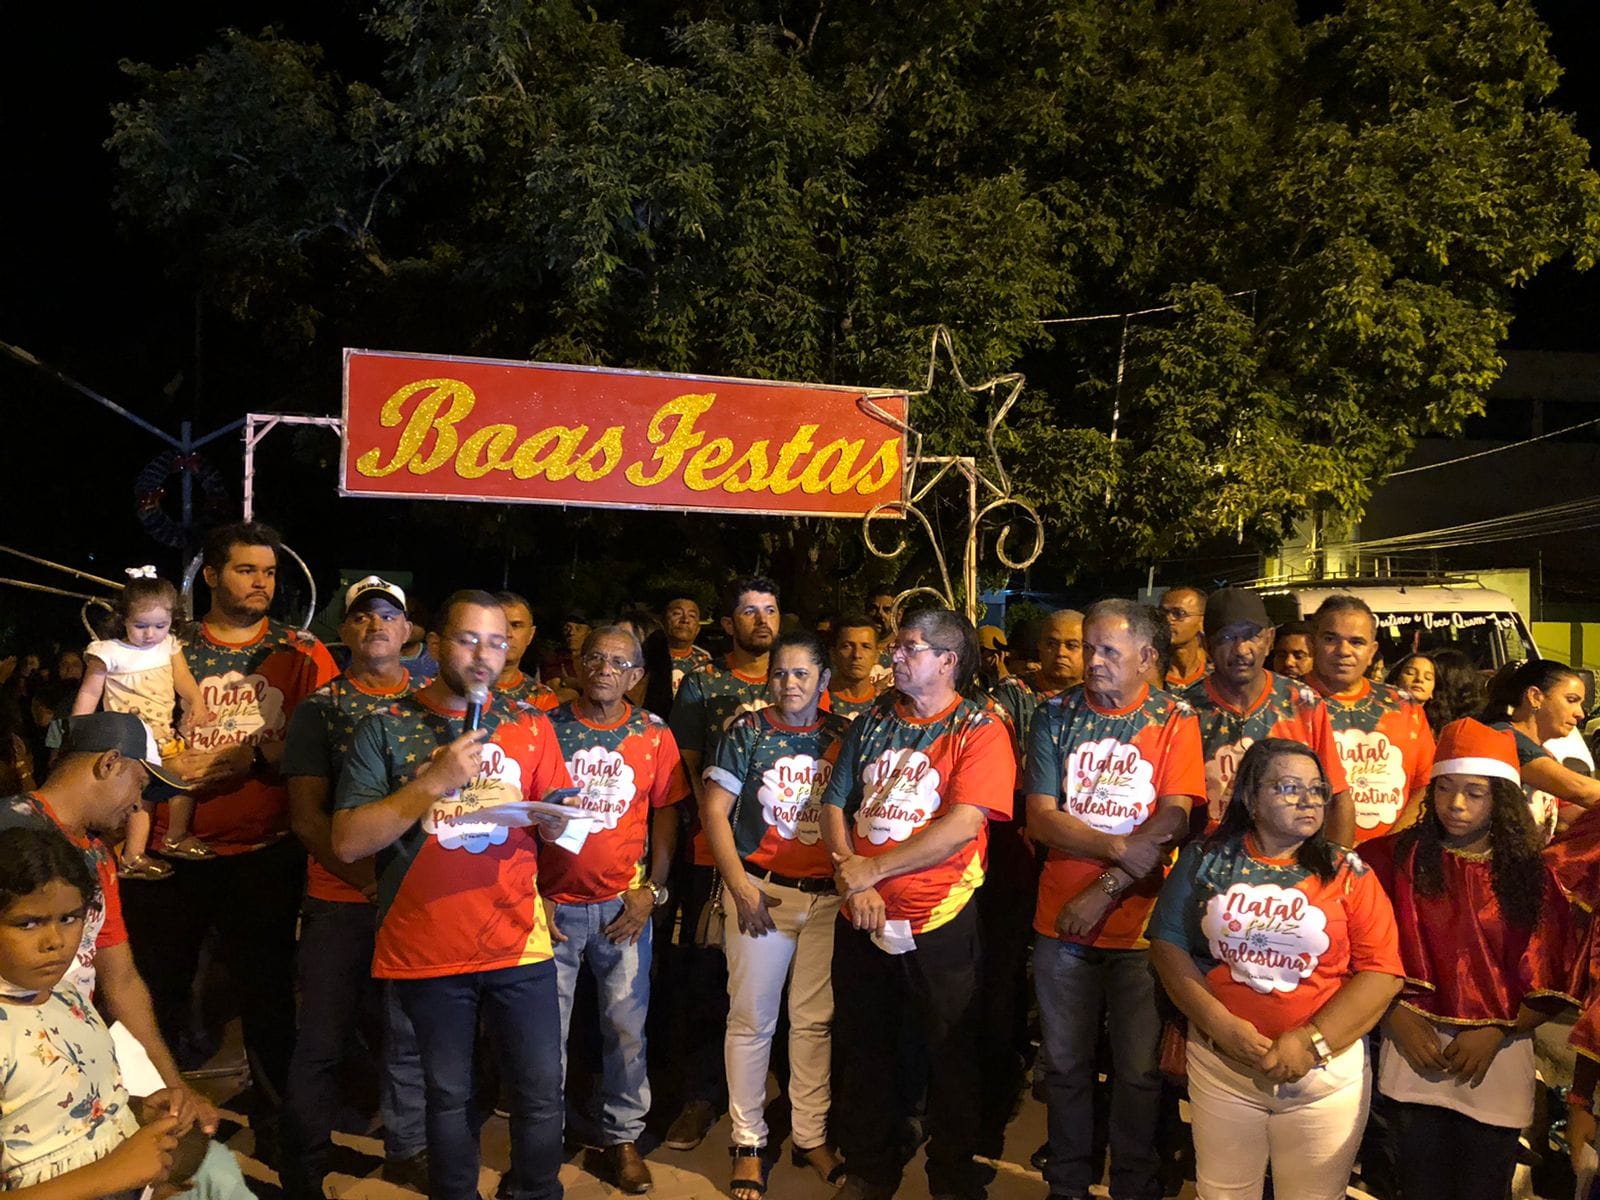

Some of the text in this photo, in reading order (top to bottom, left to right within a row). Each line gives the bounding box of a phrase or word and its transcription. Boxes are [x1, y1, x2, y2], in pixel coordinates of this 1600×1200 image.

[356, 378, 900, 495] Boas Festas
[203, 680, 267, 706] Natal
[574, 758, 623, 778] Natal
[1079, 751, 1138, 776] Natal
[779, 765, 832, 787] Natal
[580, 796, 625, 814] lestina
[1349, 786, 1400, 805] lestina
[773, 805, 820, 823] Palesti
[1070, 796, 1139, 820] Palestina
[1226, 892, 1306, 922] Natal
[1218, 940, 1312, 972] Palestina
